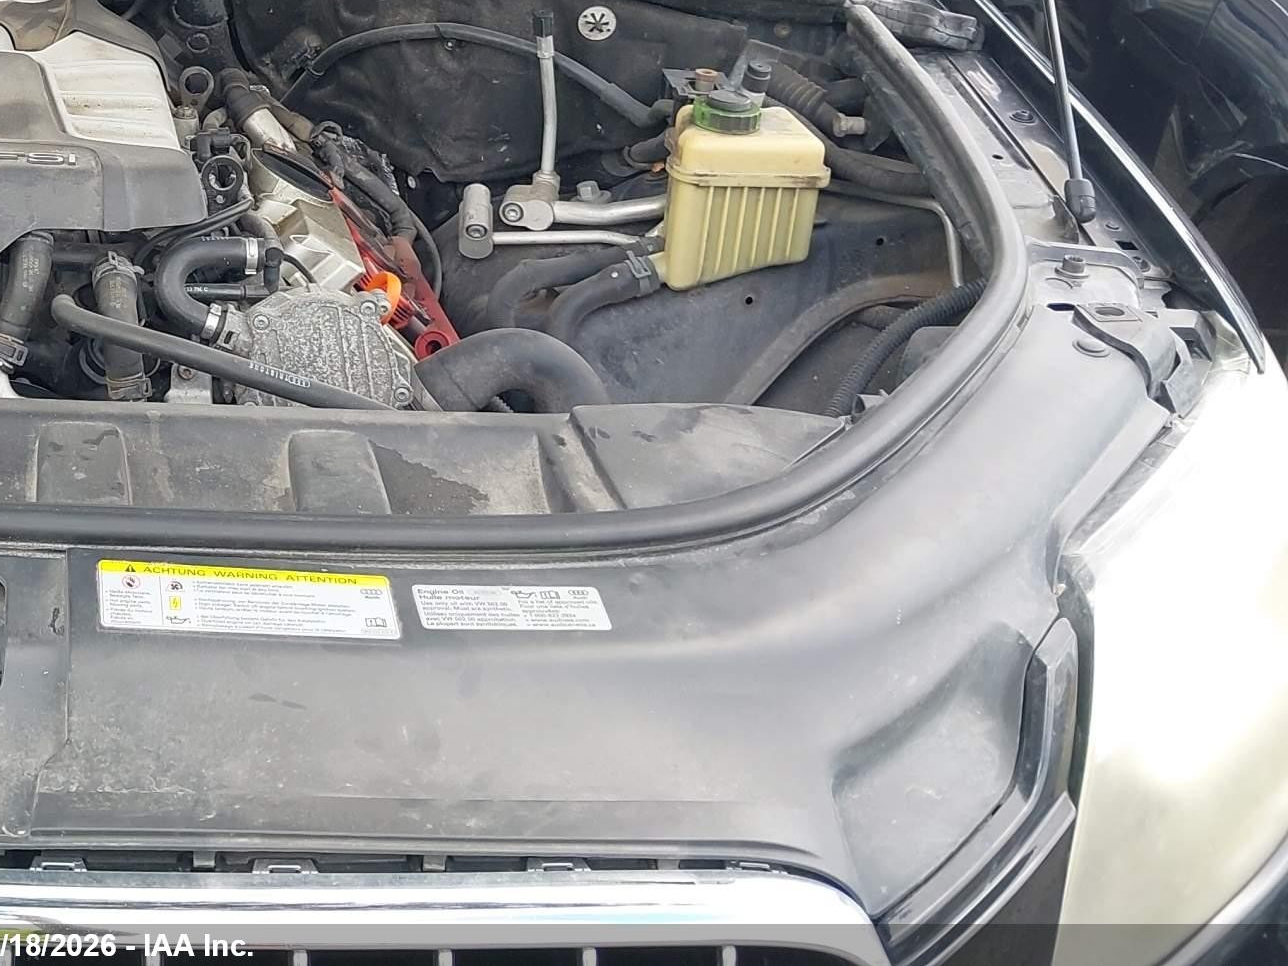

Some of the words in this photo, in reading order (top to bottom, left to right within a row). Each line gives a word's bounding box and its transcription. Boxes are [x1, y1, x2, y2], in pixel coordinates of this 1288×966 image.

[143, 566, 206, 577] ACHTUNG
[214, 570, 278, 581] WARNING
[285, 574, 358, 585] ATTENTION
[417, 588, 448, 596] Engine
